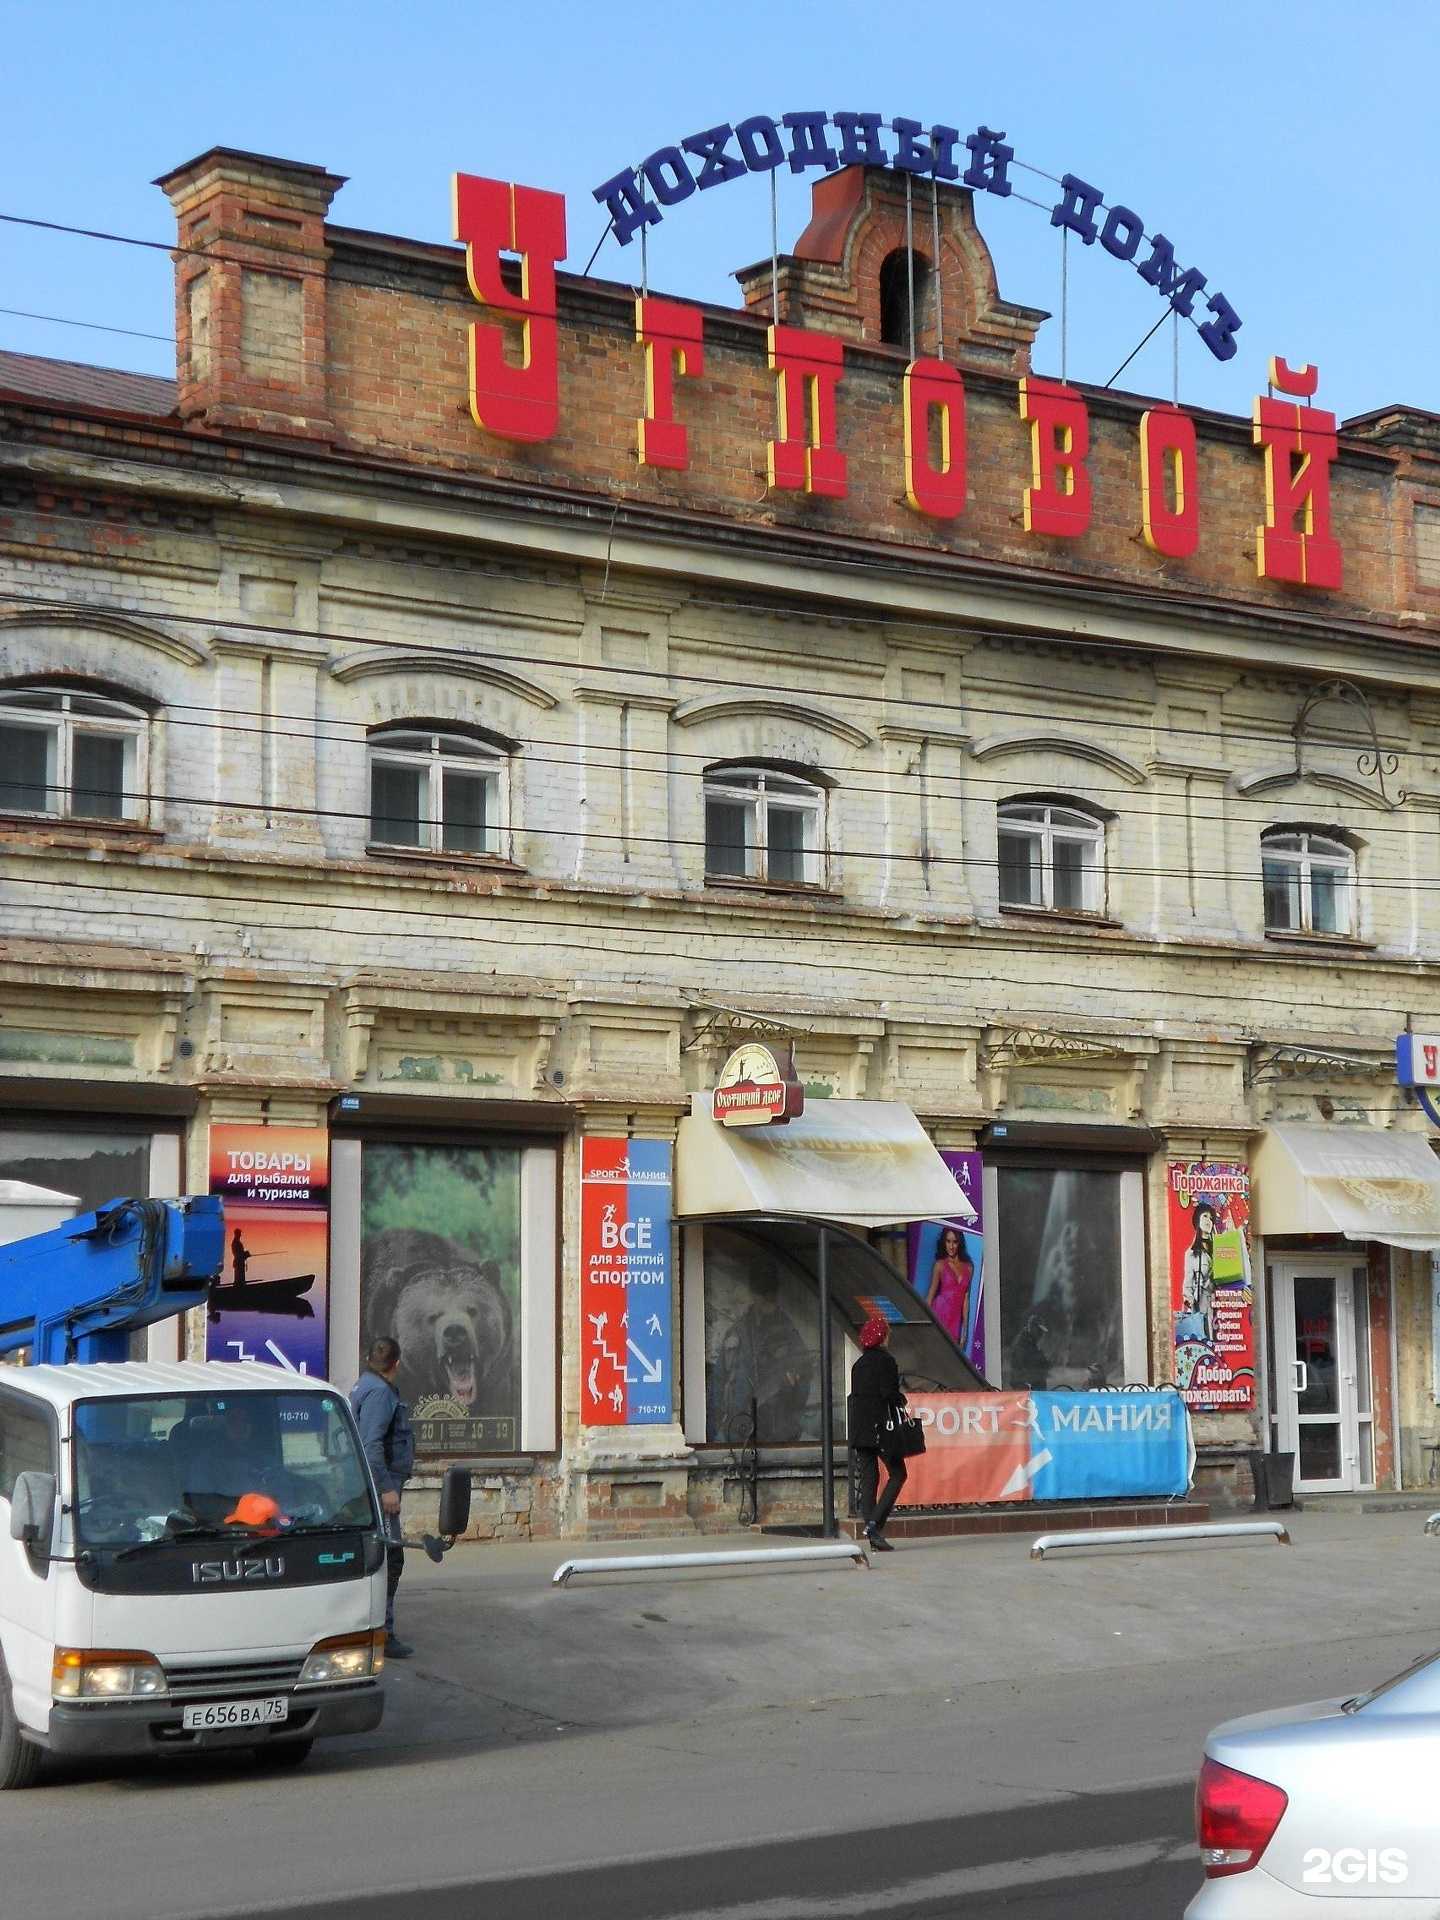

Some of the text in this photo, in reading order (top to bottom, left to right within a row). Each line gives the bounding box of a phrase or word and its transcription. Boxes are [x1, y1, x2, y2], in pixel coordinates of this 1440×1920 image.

[592, 111, 1244, 363] ДОХОДНЫЙ ДОМЪ
[452, 172, 1343, 591] УГЛОВОЙ
[227, 1151, 311, 1171] ТОВАРЫ
[227, 1173, 310, 1186] для рыбалки
[590, 1169, 666, 1180] SPORT МАНИЯ
[1173, 1170, 1245, 1195] Горожанка
[247, 1188, 310, 1200] и туризма
[602, 1217, 652, 1249] ВСЁ
[589, 1252, 664, 1266] для занятий
[590, 1271, 664, 1288] спортом
[1197, 1363, 1232, 1384] Добро
[912, 1404, 1171, 1435] PORT МАНИЯ
[193, 1557, 286, 1583] ISUZU
